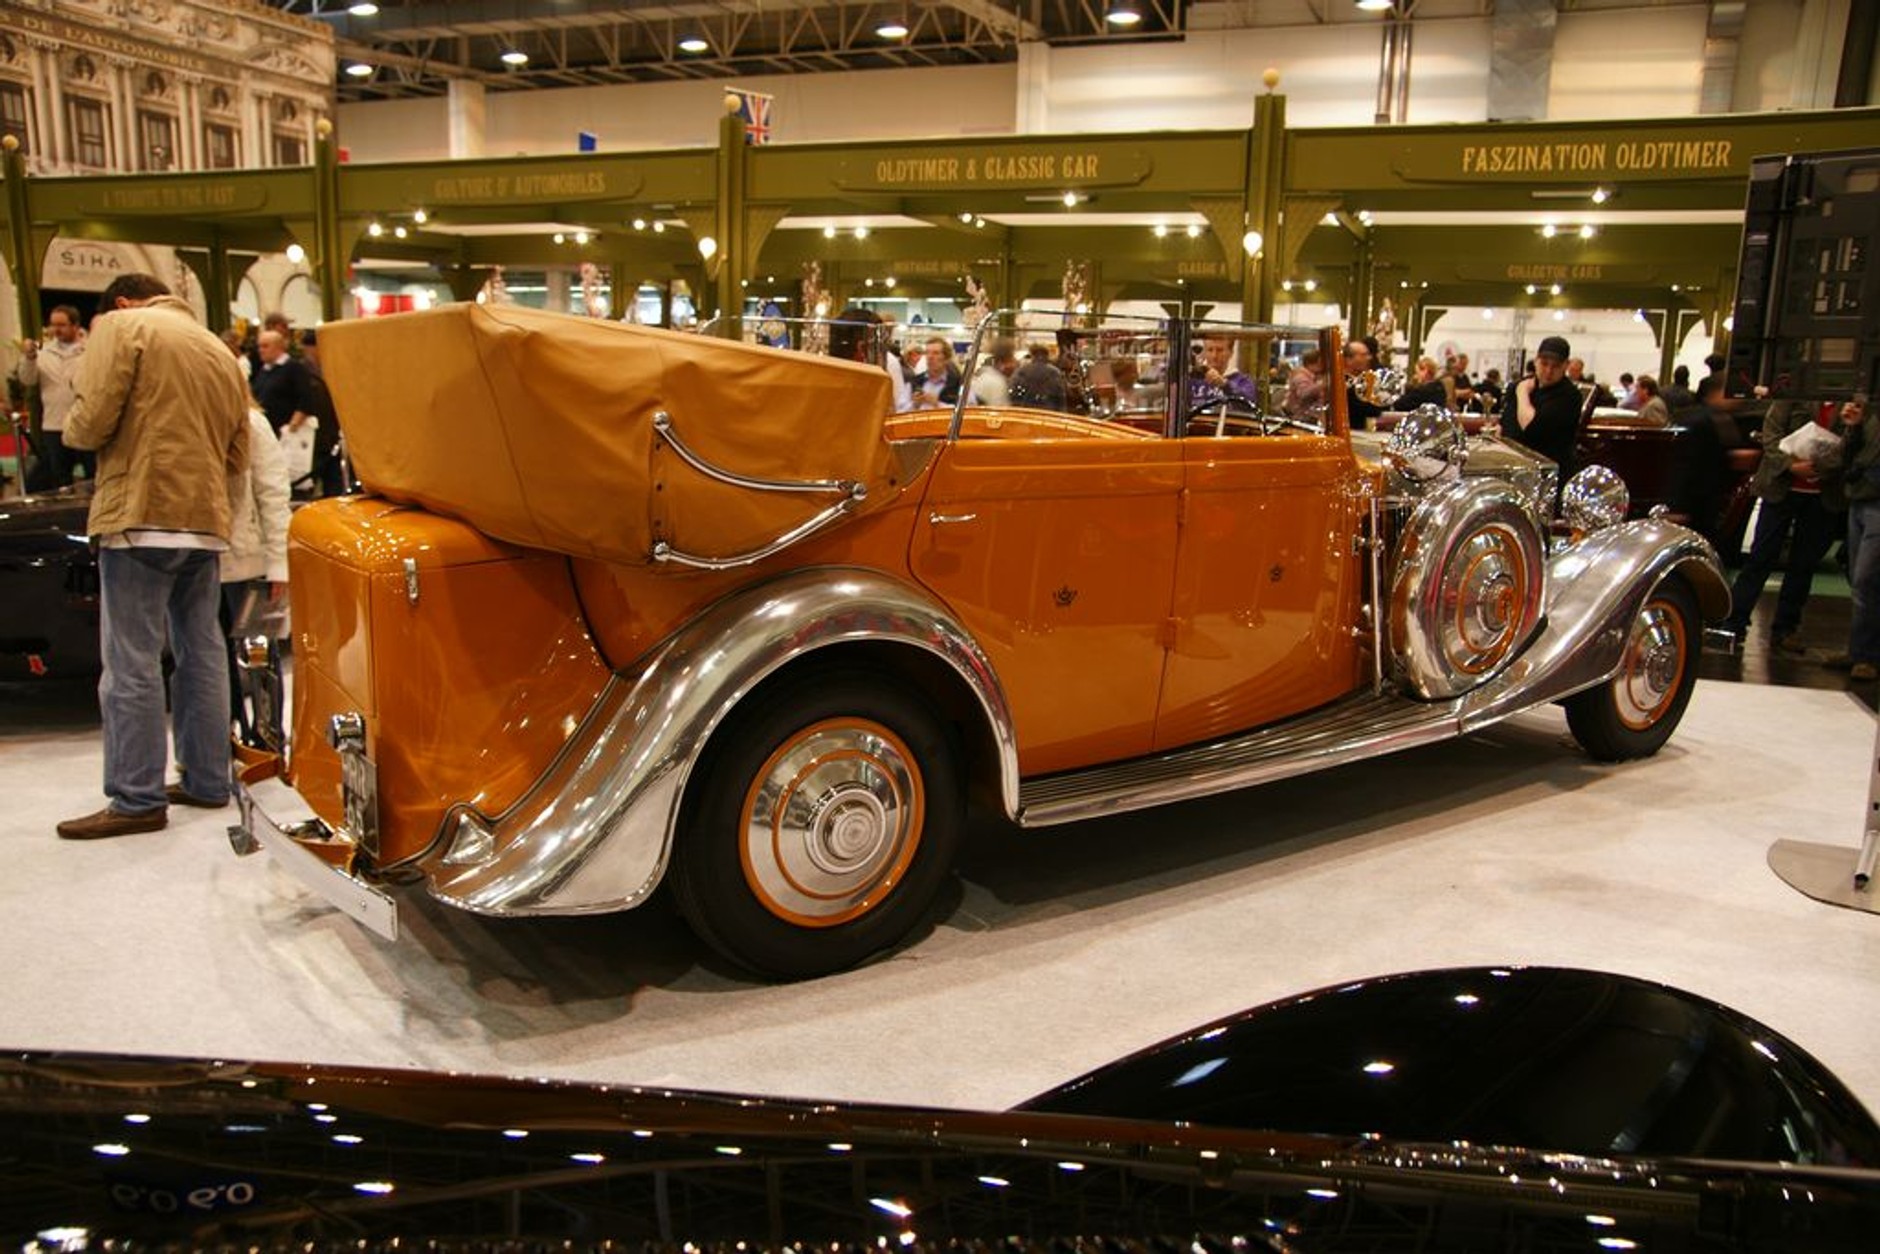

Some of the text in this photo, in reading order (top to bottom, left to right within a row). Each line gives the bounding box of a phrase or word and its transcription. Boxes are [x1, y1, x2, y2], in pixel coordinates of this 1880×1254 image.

[876, 153, 1099, 182] OLDTIMER & CLASSIC CAR
[1462, 140, 1732, 173] FASZINATION OLDTIMER
[435, 176, 493, 199] CULTURE
[514, 171, 606, 197] AUTOMOBILES
[60, 250, 121, 269] SIHA
